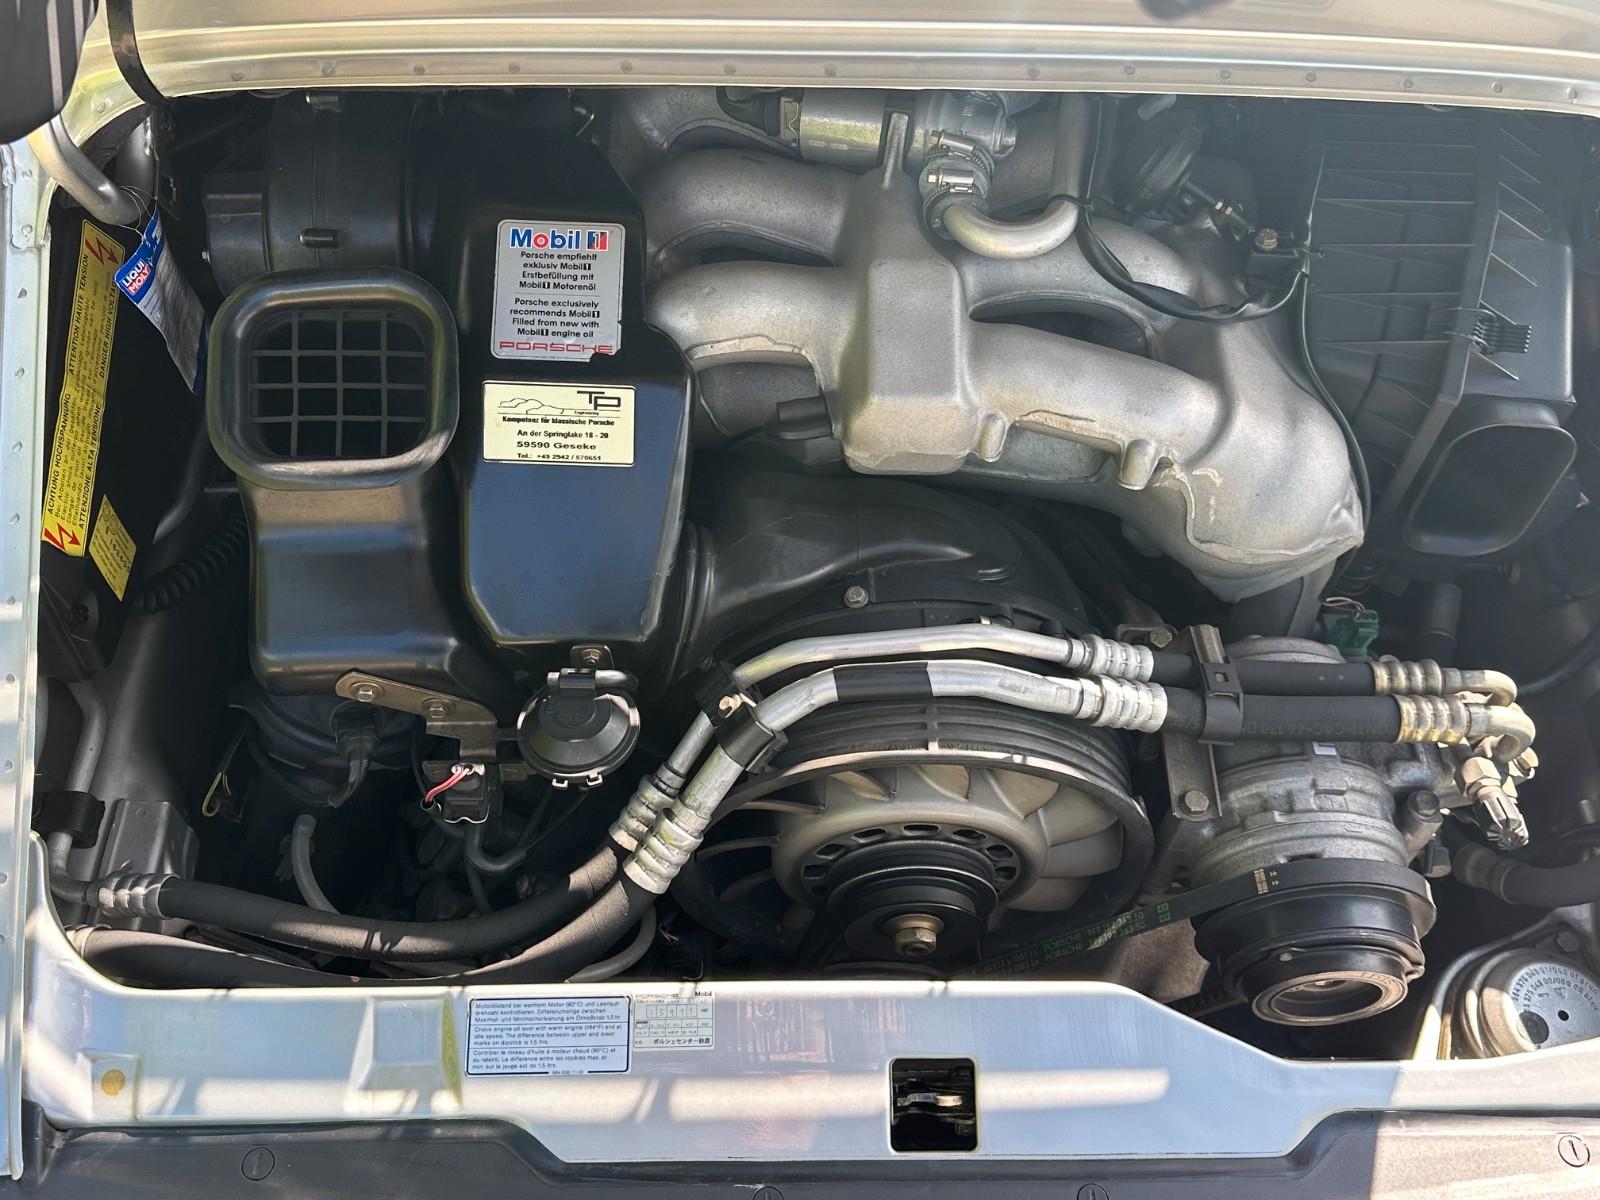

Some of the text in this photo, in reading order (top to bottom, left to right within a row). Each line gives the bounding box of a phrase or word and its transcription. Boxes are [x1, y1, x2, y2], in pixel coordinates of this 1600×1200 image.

[510, 228, 580, 249] Mobil
[520, 252, 598, 261] Porsche empfiehlt
[523, 262, 558, 270] exklusiv
[122, 260, 144, 287] LIQUI
[522, 272, 578, 281] Erstbefüllung
[128, 265, 150, 294] MOLY
[552, 282, 596, 291] Motorenöl
[514, 298, 599, 309] Porsche exclusively
[67, 254, 89, 375] ATTENTION HAUTE TENSION
[510, 309, 566, 317] recommends
[552, 330, 581, 338] engine
[500, 341, 612, 353] PORSCHE
[99, 340, 108, 377] DANGER
[577, 390, 621, 410] TP
[502, 416, 539, 424] Kompetenz
[544, 430, 583, 438] Springlake
[516, 441, 550, 449] 59590
[48, 392, 70, 514] ACHTUNG HOCHSPANNUNG
[78, 473, 90, 529] ATTENZIONE
[90, 403, 101, 446] TENSIONE
